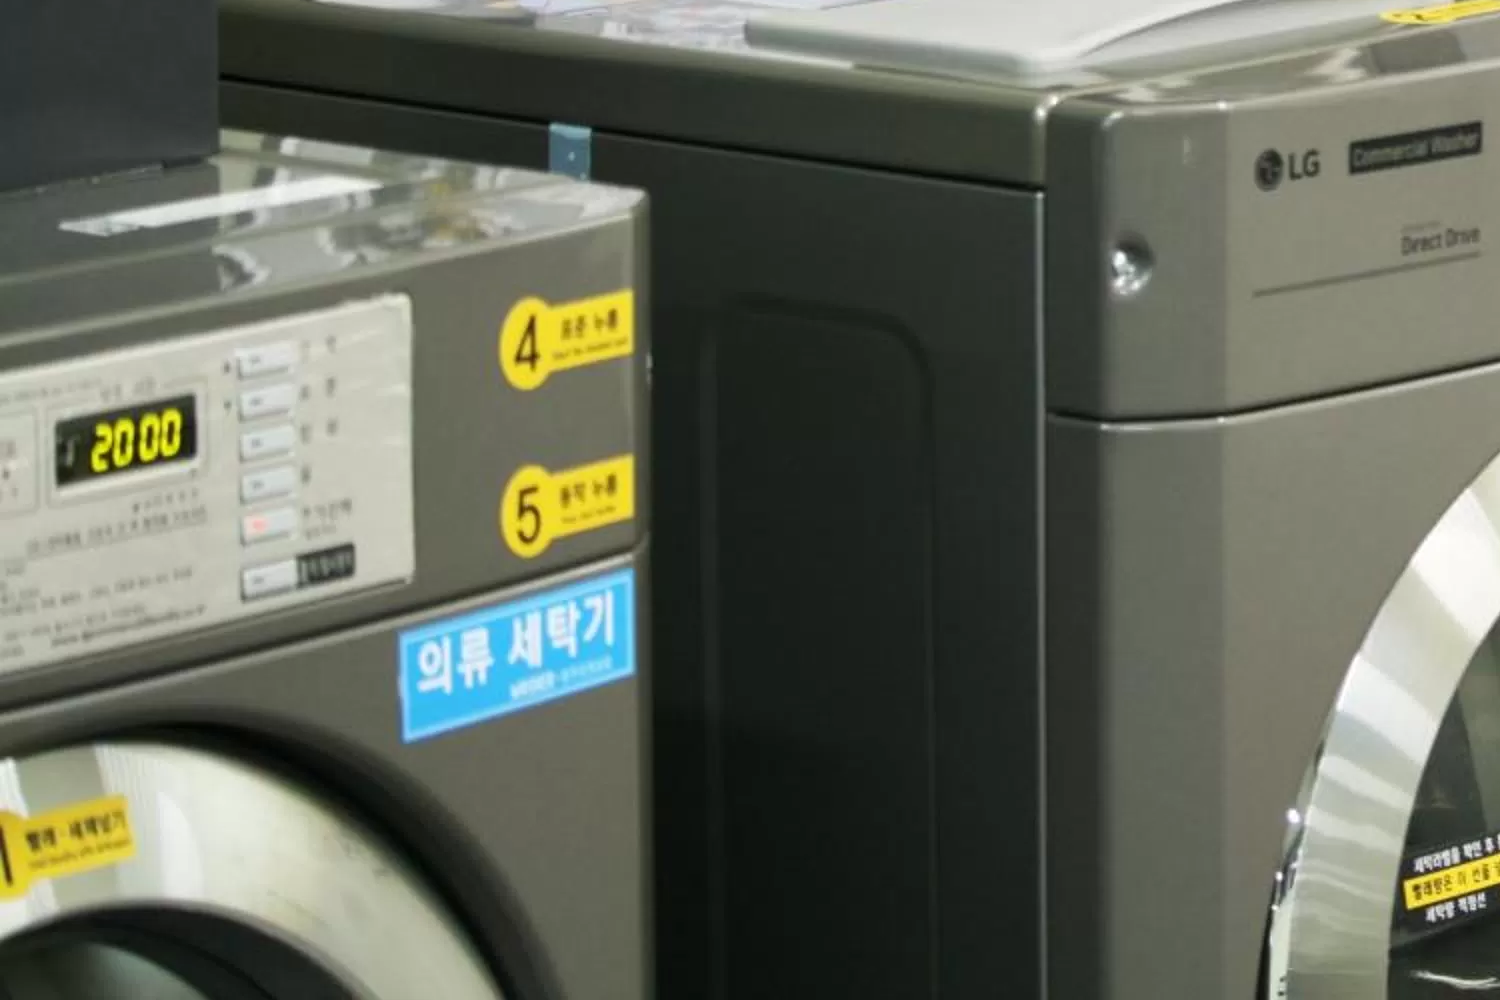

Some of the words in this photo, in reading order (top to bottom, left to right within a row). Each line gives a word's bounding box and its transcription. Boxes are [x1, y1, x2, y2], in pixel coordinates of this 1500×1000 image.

[1288, 146, 1321, 181] LG
[1400, 232, 1442, 257] Direct
[1445, 227, 1482, 248] Drive
[515, 313, 541, 372] 4
[90, 407, 183, 474] 2000
[516, 483, 542, 545] 5
[416, 626, 496, 696] 의류
[508, 588, 614, 669] 세탁기
